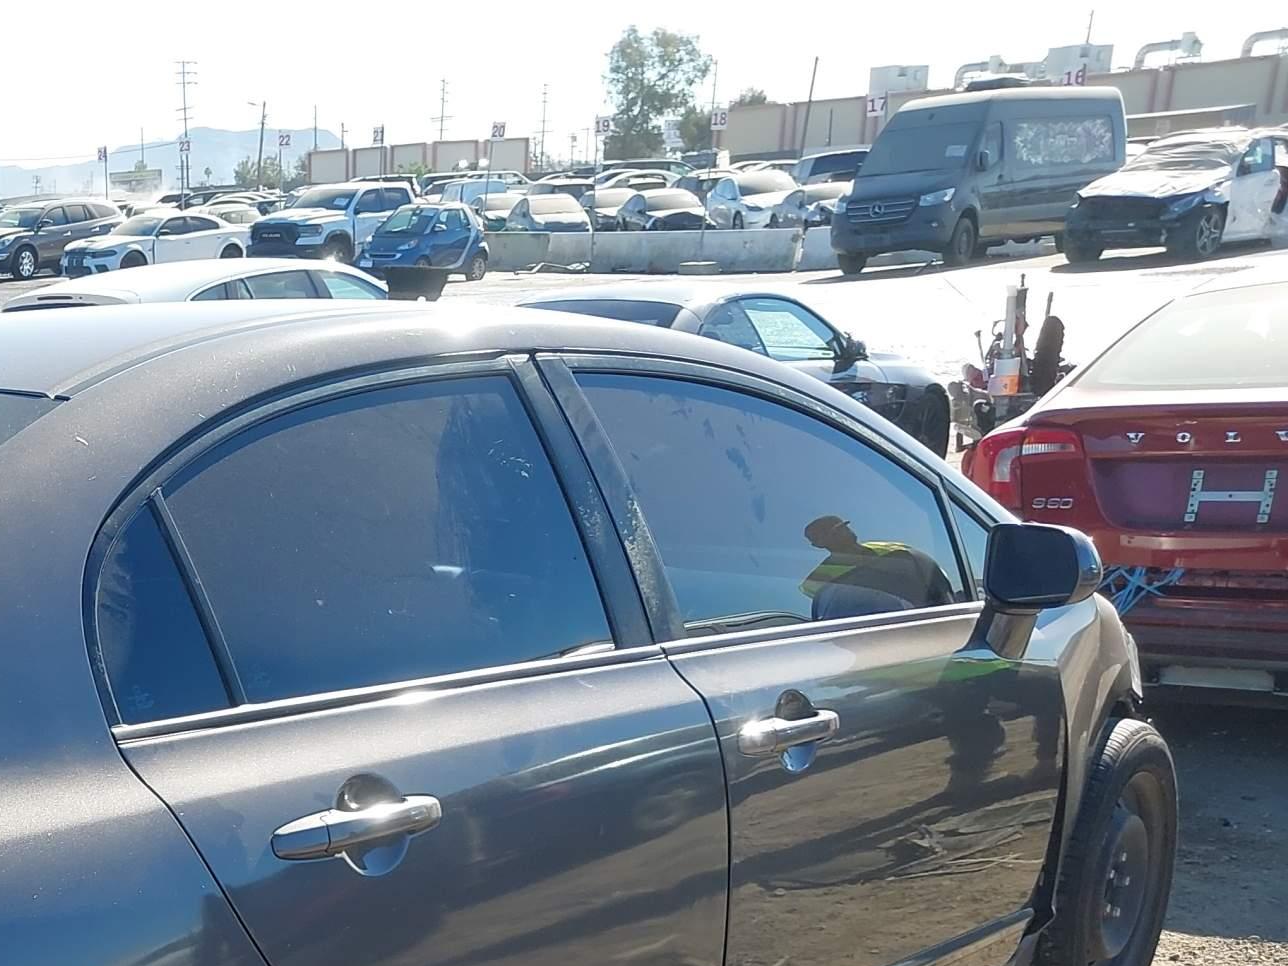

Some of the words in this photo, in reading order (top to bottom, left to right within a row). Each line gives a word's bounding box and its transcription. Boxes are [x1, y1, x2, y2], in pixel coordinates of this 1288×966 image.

[868, 96, 887, 112] 17
[595, 119, 610, 133] 19
[712, 111, 727, 127] 18
[491, 124, 506, 138] 20
[179, 140, 191, 152] 23
[278, 134, 291, 146] 22
[1031, 498, 1073, 509] S60
